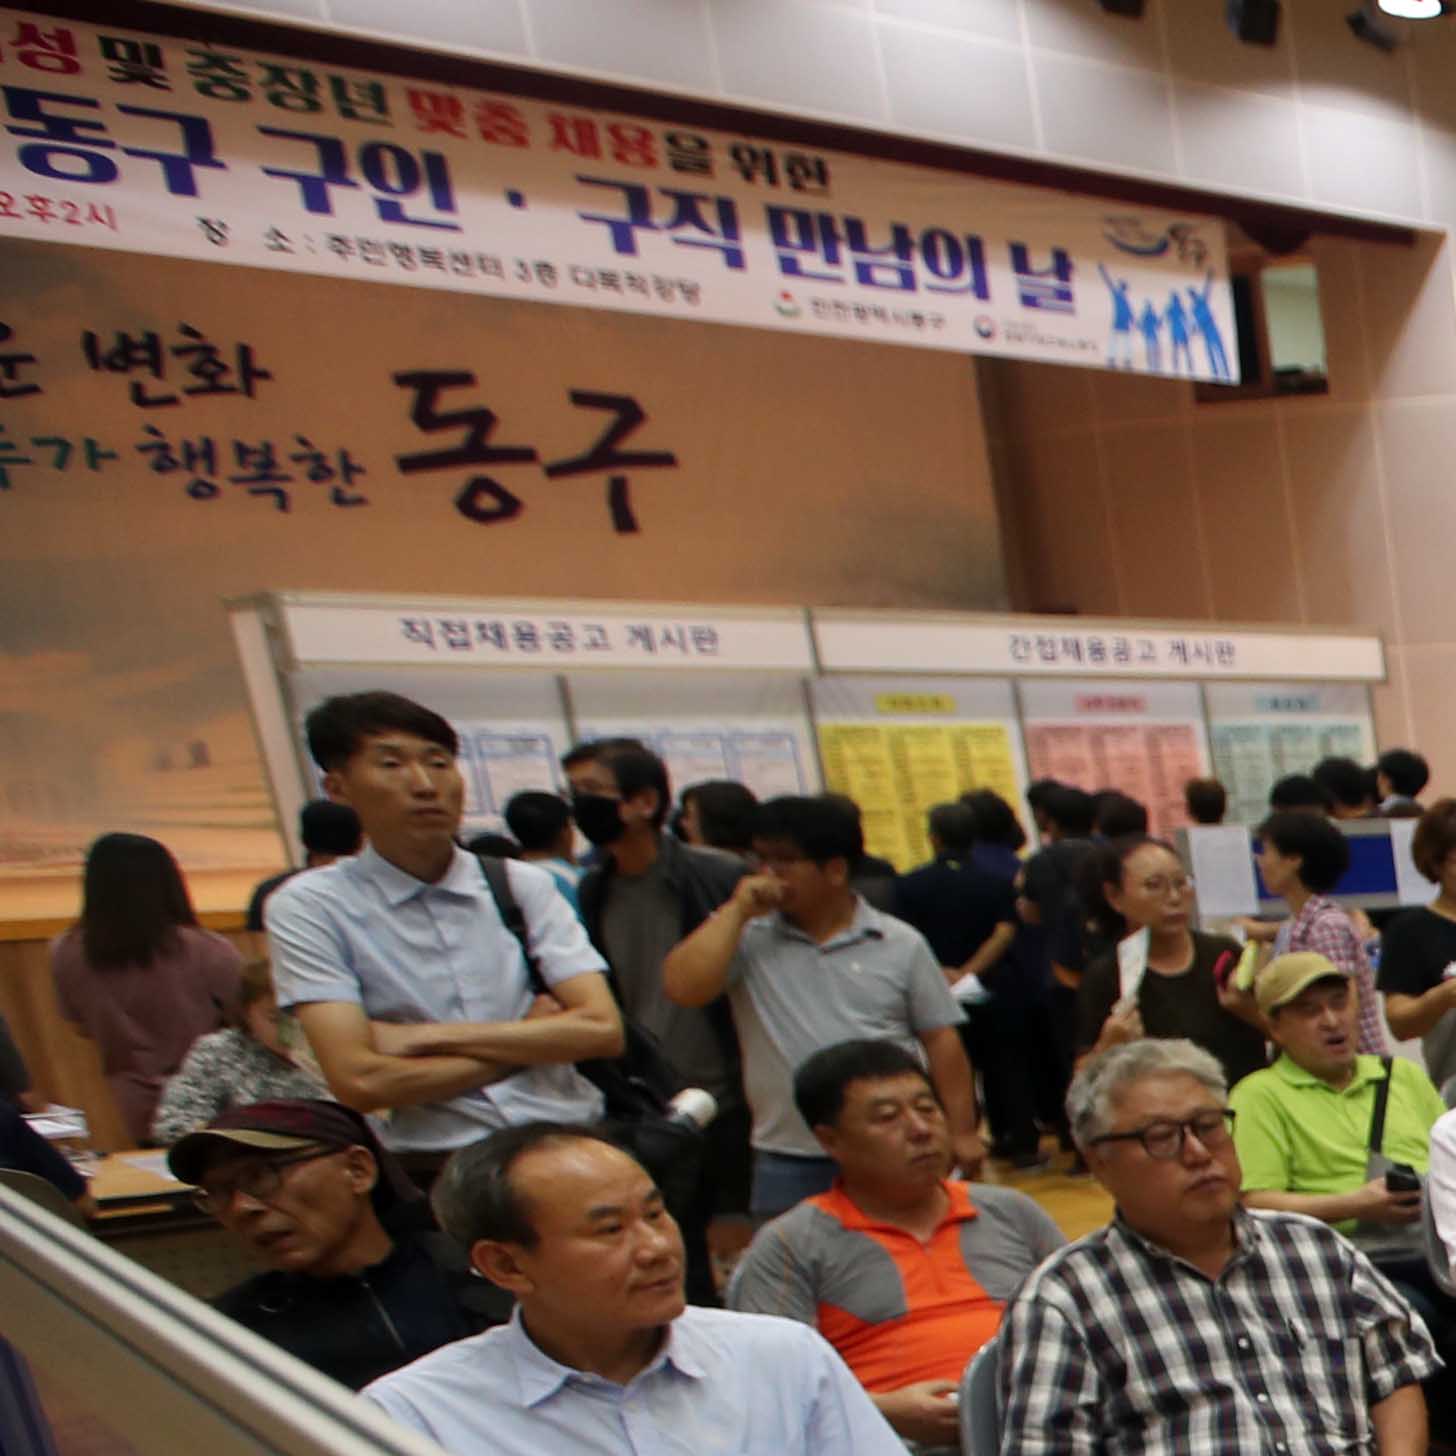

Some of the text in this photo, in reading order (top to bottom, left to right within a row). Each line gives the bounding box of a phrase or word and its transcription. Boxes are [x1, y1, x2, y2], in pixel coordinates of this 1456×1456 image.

[0, 20, 831, 194] 성 및 중장년 맞춤 채용을 위한
[0, 85, 228, 199] 동구
[256, 124, 464, 232] 구인
[574, 173, 748, 270] 구직
[764, 202, 992, 301] 만남의
[1007, 239, 1077, 316] 날
[82, 322, 274, 409] 변화
[134, 423, 371, 514] 행복한
[391, 370, 679, 535] 동구
[399, 617, 720, 656] 직접채용공고 게시판
[1008, 633, 1237, 666] 간접채용공고 게시판
